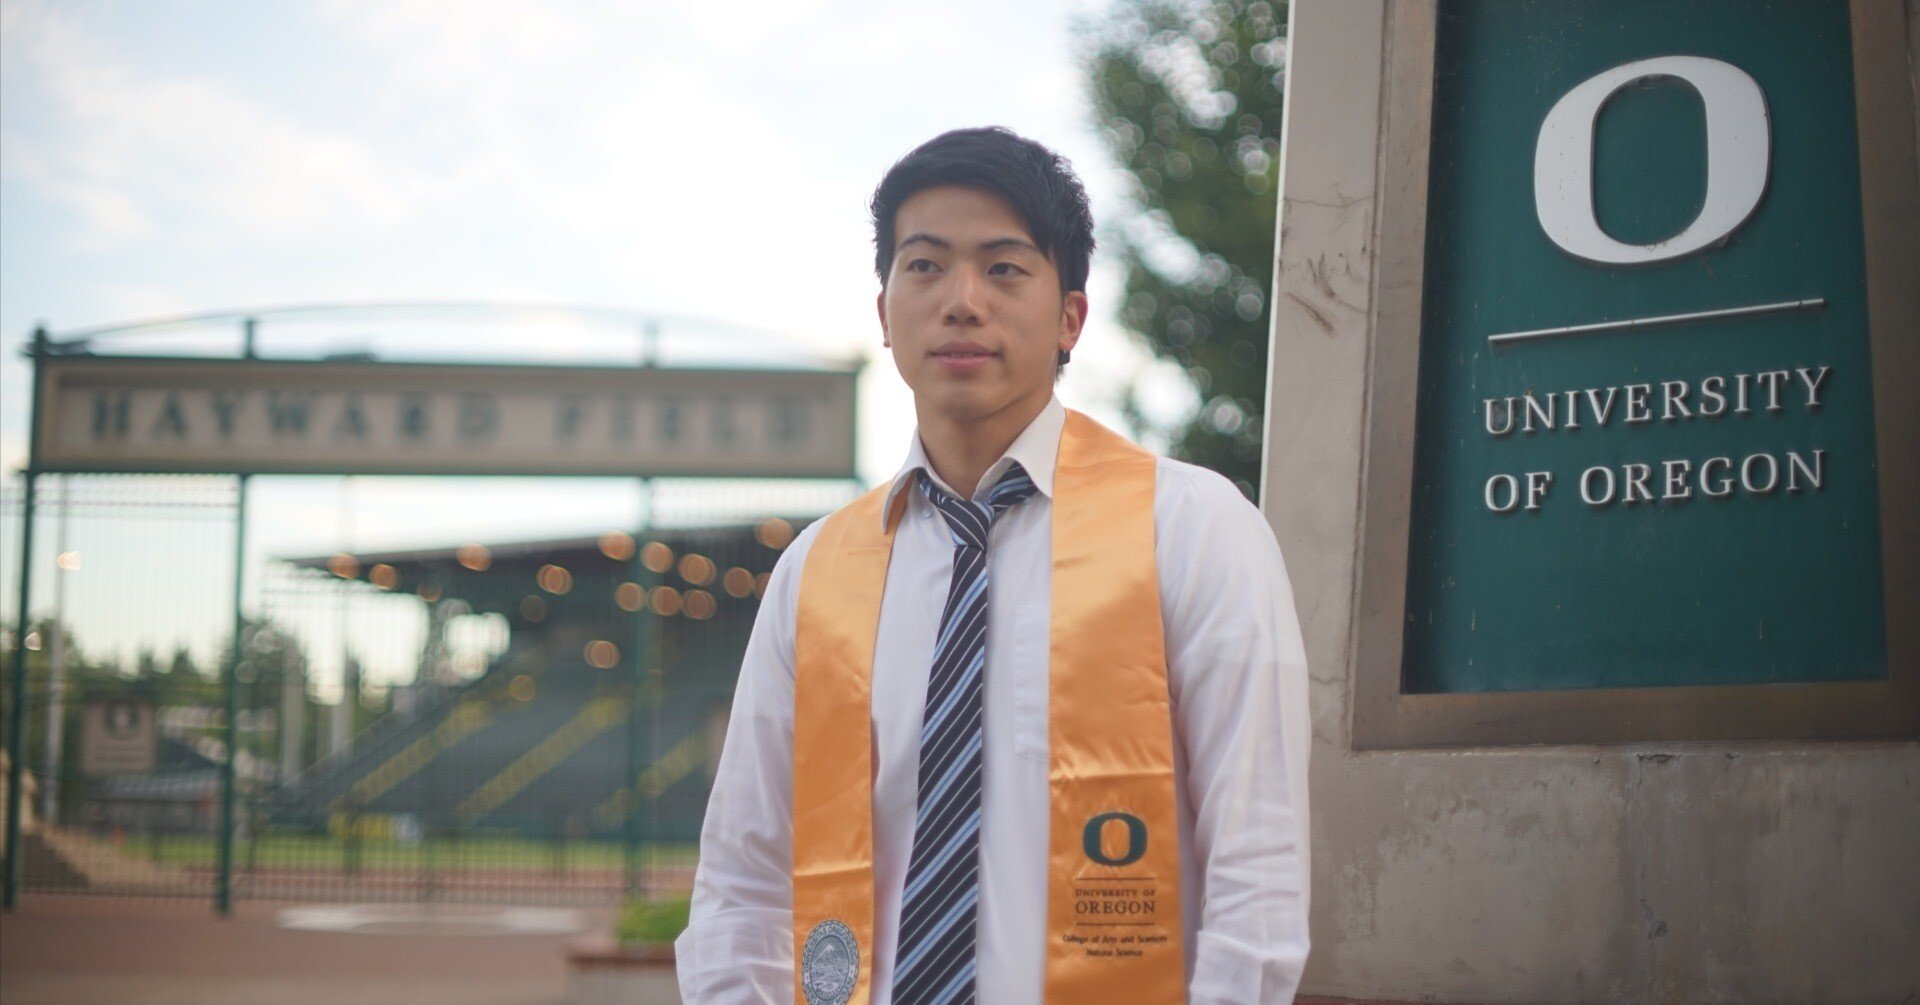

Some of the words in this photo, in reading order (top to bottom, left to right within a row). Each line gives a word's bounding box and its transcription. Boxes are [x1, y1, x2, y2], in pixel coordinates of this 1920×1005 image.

[1535, 55, 1771, 264] O
[93, 389, 498, 440] HAYWARD
[1483, 366, 1829, 435] UNIVERSITY
[1484, 471, 1554, 512] OF
[1580, 450, 1825, 505] OREGON
[1083, 812, 1148, 867] O
[1075, 889, 1138, 897] UNIVERSITY
[1142, 889, 1156, 897] OF
[1075, 900, 1156, 915] OREGON
[1062, 935, 1089, 944] College
[1091, 935, 1100, 943] of
[1102, 935, 1118, 943] Arts
[1120, 935, 1135, 943] and
[1138, 935, 1168, 943] Sciences
[1086, 949, 1114, 957] Natural
[1116, 949, 1143, 957] Science
